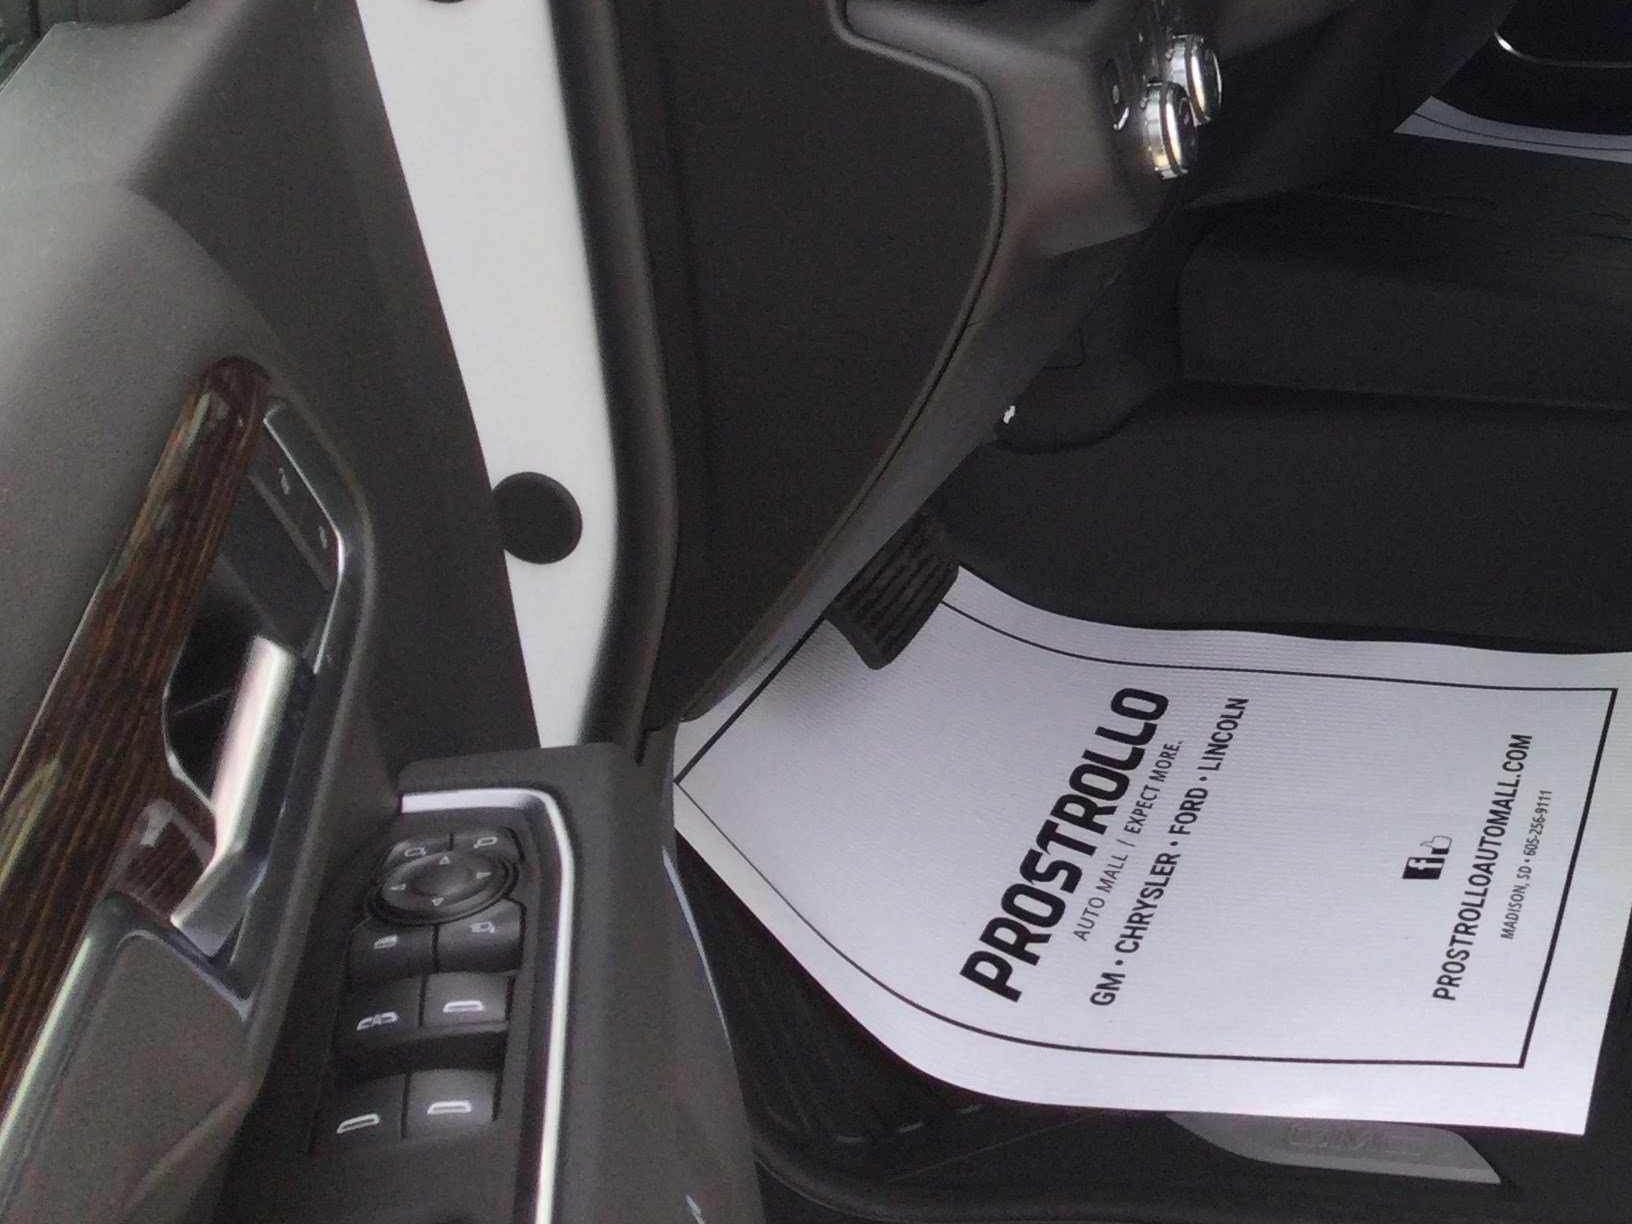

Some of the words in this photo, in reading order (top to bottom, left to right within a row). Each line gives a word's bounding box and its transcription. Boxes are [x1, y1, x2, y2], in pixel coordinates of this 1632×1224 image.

[958, 687, 1170, 1004] PROSTROLLO
[1072, 895, 1106, 942] AUTO
[1096, 853, 1129, 893] MALL
[1123, 783, 1161, 835] EXPECT
[1148, 740, 1183, 783] MORE.
[1088, 971, 1127, 1007] GM
[1113, 851, 1182, 954] CHRYSLER
[1168, 787, 1209, 836] FORD
[1197, 697, 1250, 772] LINCOLN
[1432, 733, 1533, 1002] PROSTROLLOAUTOMALL.COM
[1500, 881, 1531, 940] MADISON,
[1516, 864, 1533, 882] SD
[1523, 789, 1553, 857] 605-256-9111
